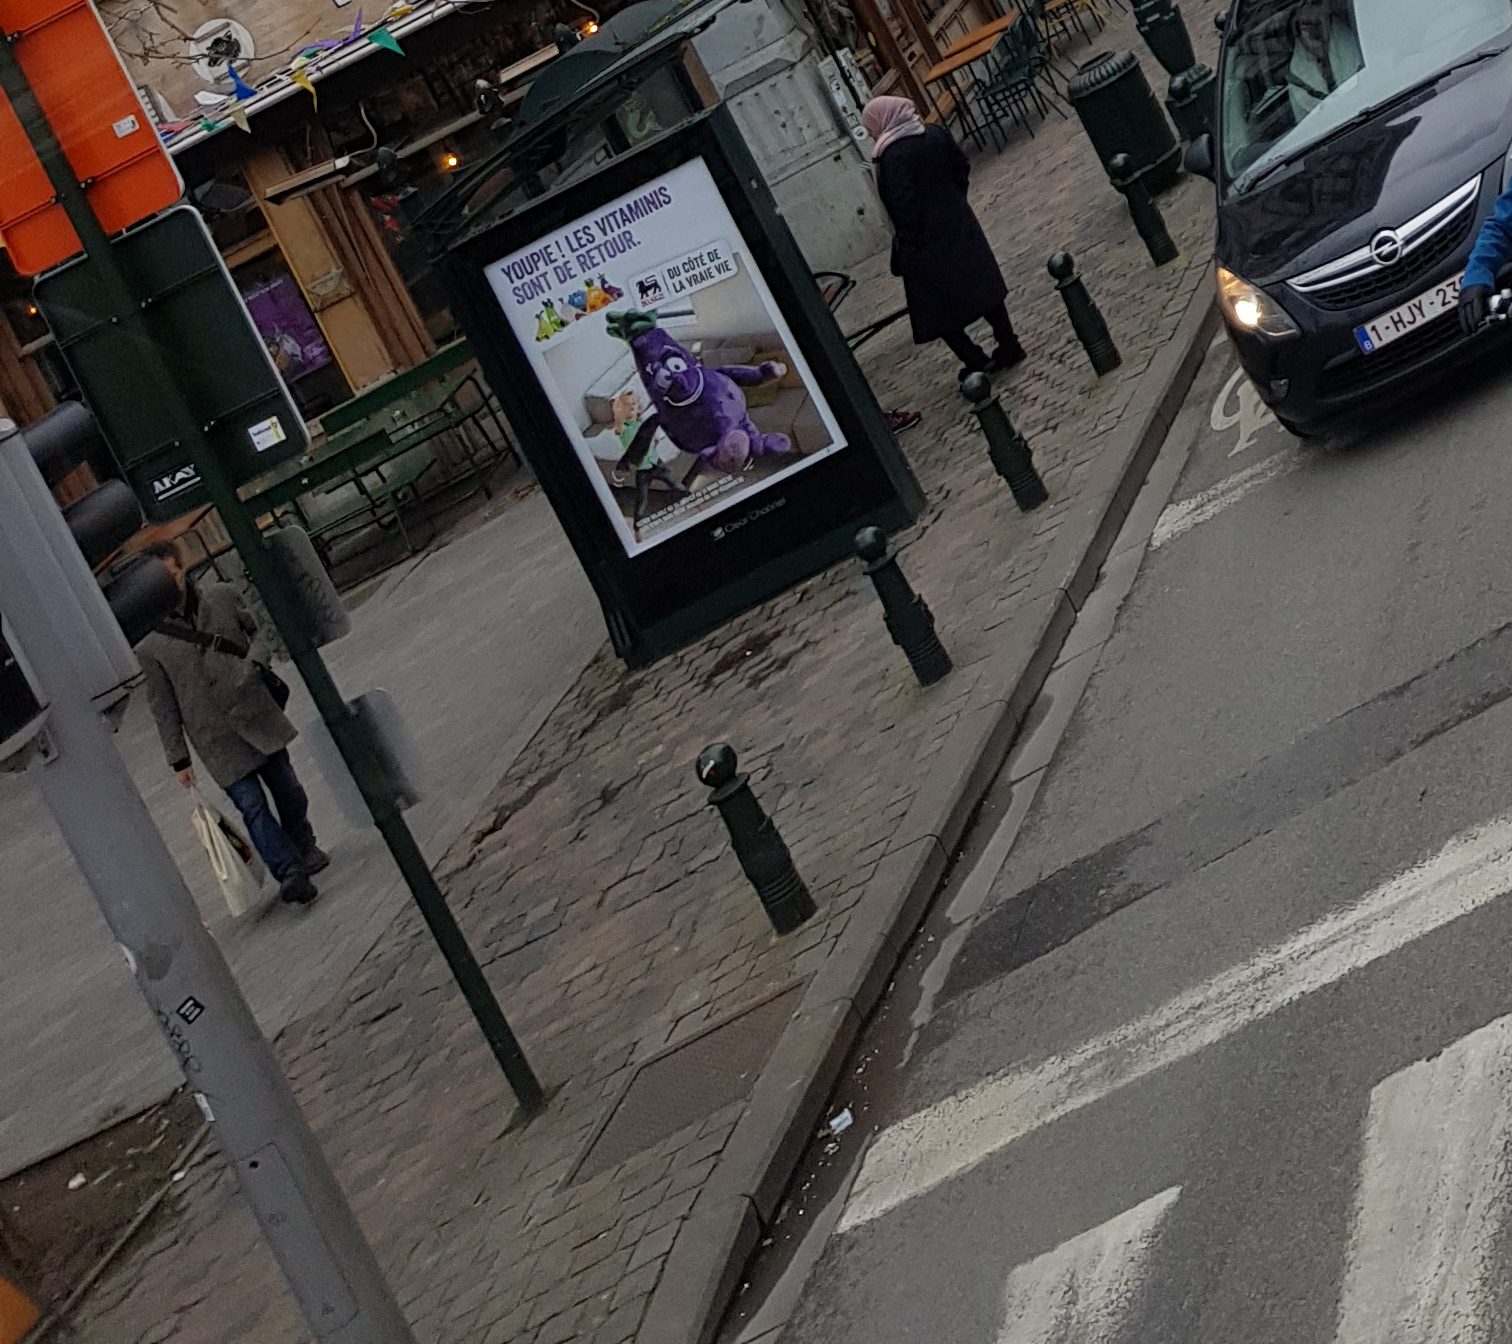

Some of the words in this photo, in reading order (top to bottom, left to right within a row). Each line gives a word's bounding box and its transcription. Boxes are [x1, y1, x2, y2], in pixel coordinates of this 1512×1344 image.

[501, 241, 557, 285] YOUPIE
[565, 225, 596, 253] LES
[594, 186, 672, 237] VITAMINIS
[512, 272, 551, 305] SONT
[553, 260, 577, 285] DE
[576, 229, 641, 274] RETOUR.
[667, 263, 681, 279] DU
[682, 252, 707, 275] CÔTÉ
[708, 248, 722, 264] DE
[673, 280, 686, 294] LA
[686, 269, 715, 289] VRAIE
[715, 260, 733, 277] VIE
[1369, 274, 1464, 342] 1-HJY-23
